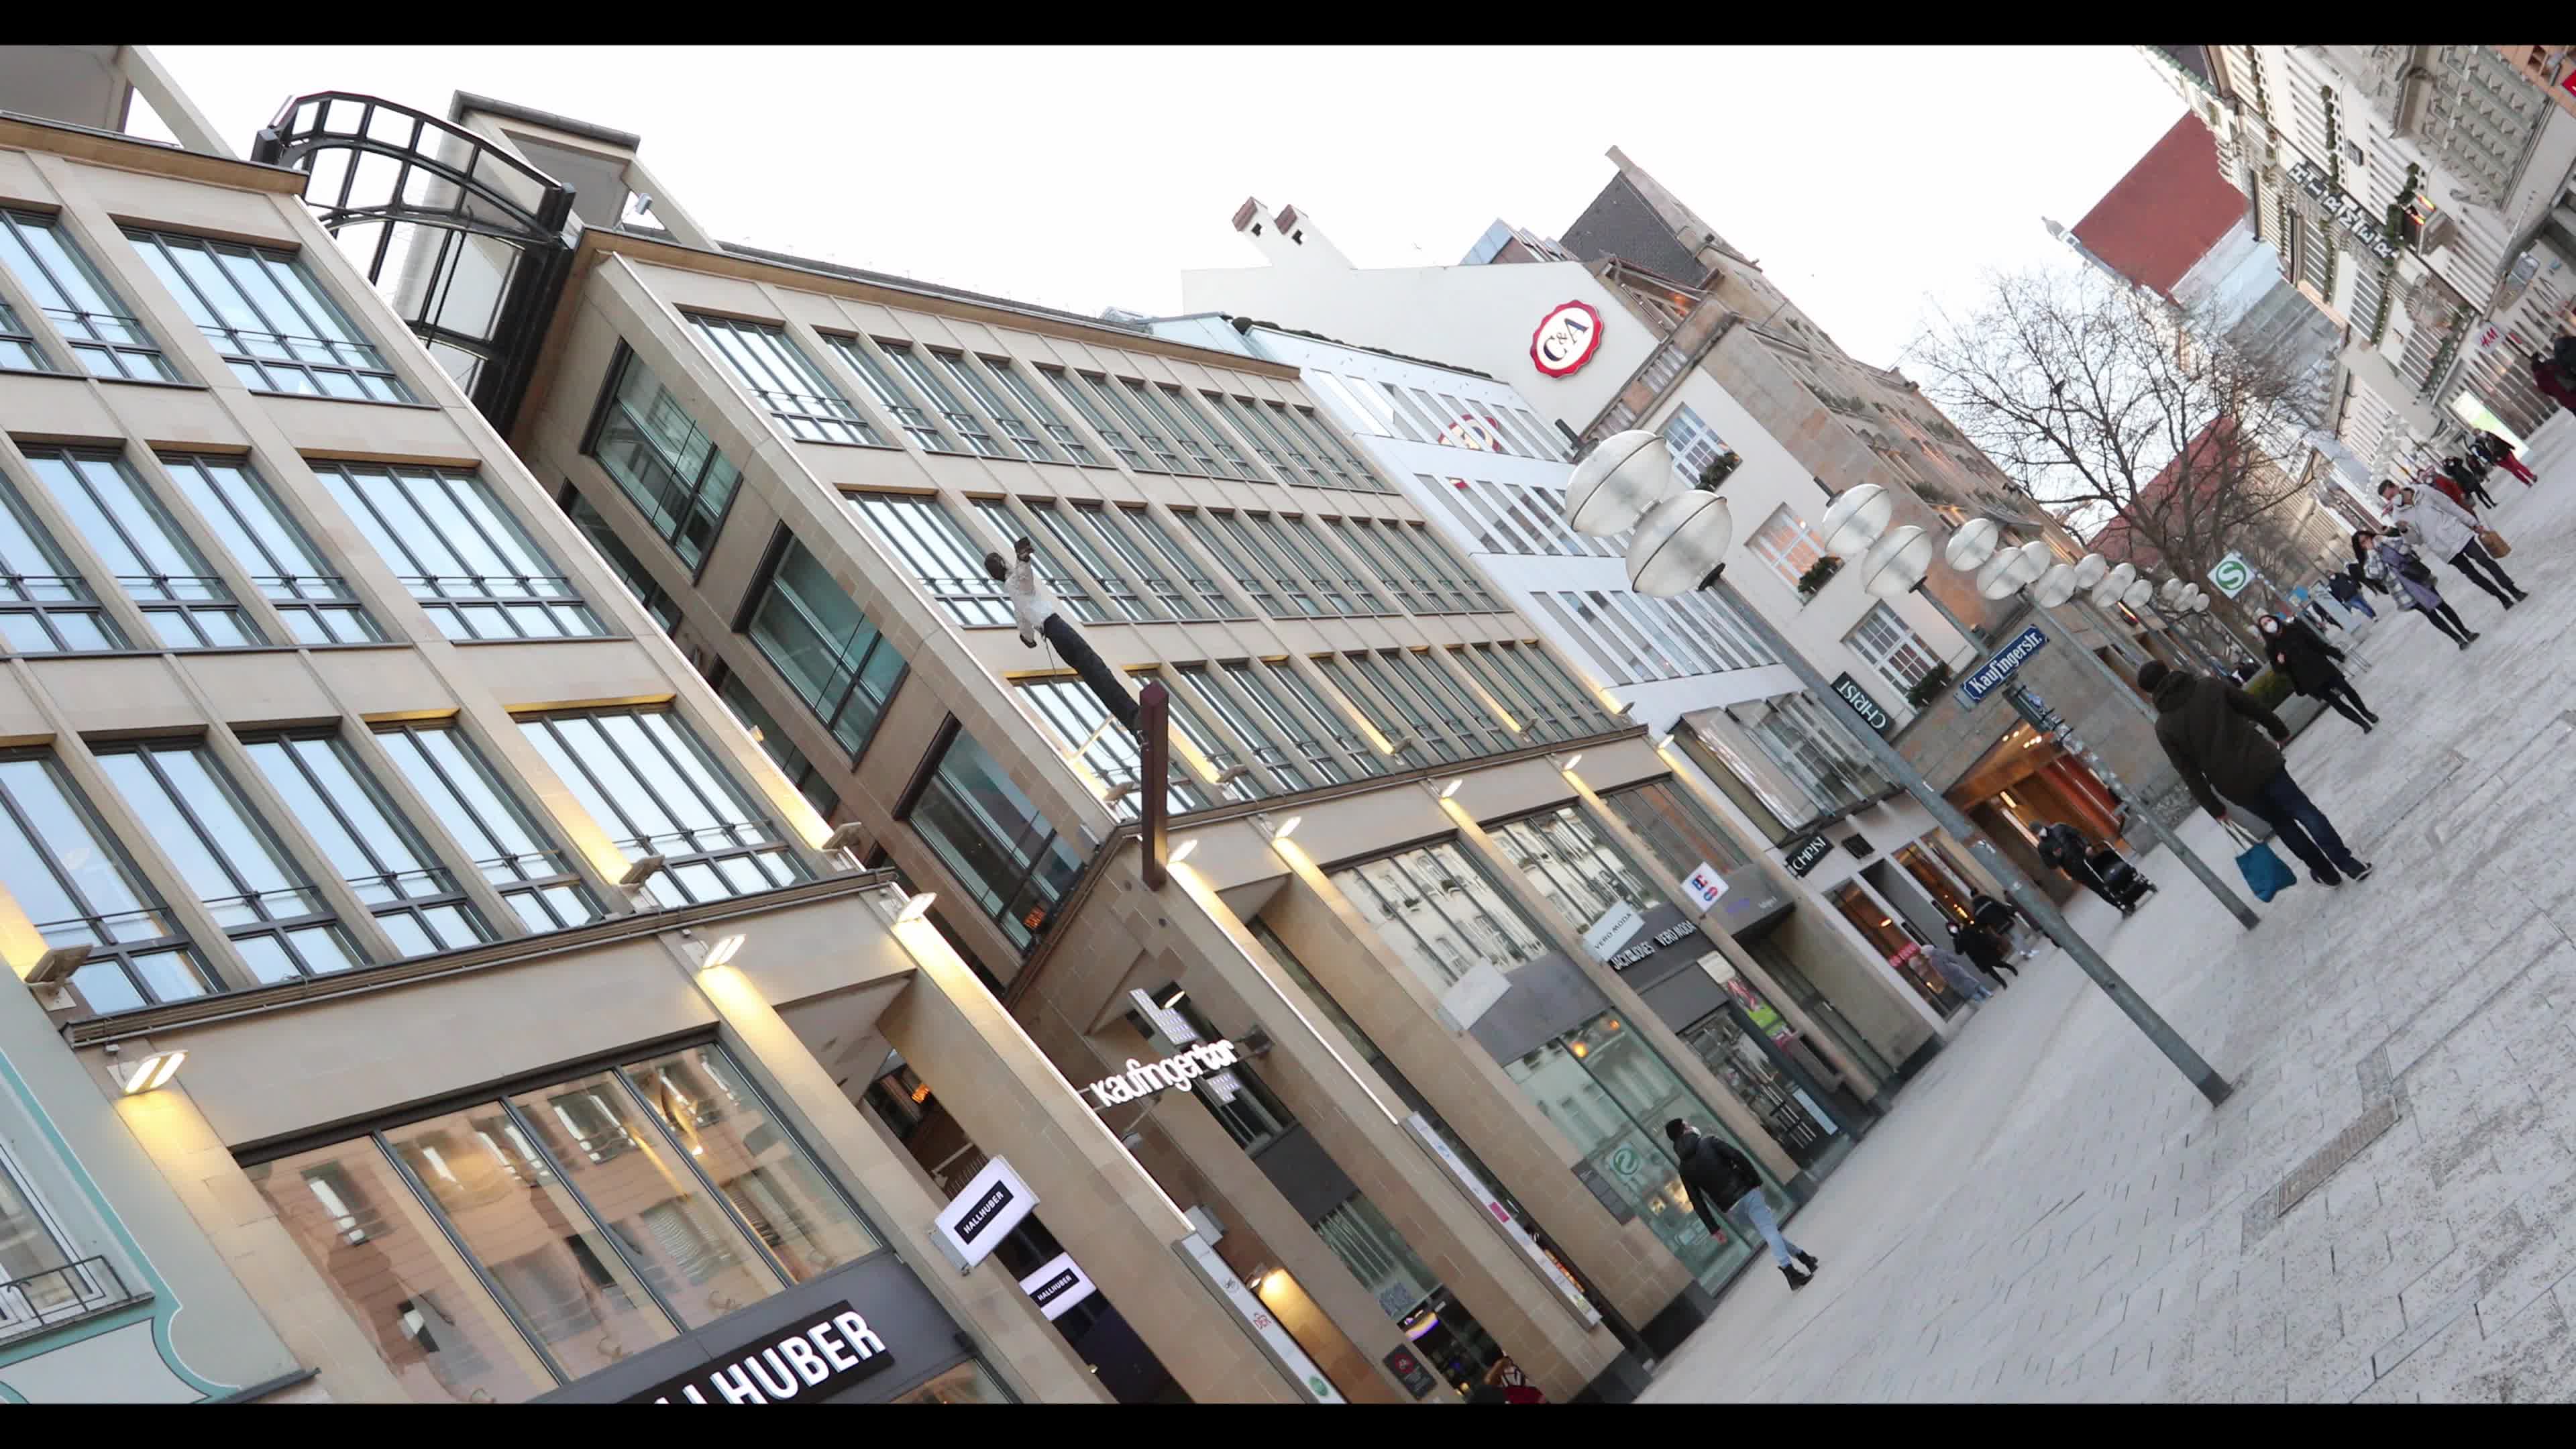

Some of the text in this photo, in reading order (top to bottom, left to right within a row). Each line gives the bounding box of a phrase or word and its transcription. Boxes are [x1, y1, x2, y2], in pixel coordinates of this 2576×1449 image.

[2289, 165, 2392, 258] HIRMER
[1544, 318, 1589, 362] C&A
[1968, 632, 2042, 694] Kaufingerstr.
[1837, 680, 1886, 730] CHRIST
[1791, 837, 1827, 871] CHRIST
[1595, 912, 1632, 950] VERO MODA
[1655, 920, 1697, 947] VERO MODA
[963, 1191, 1004, 1234] HALLHUBER
[1037, 1274, 1072, 1301] HALLHUBER
[655, 1311, 886, 1404] HUBER
